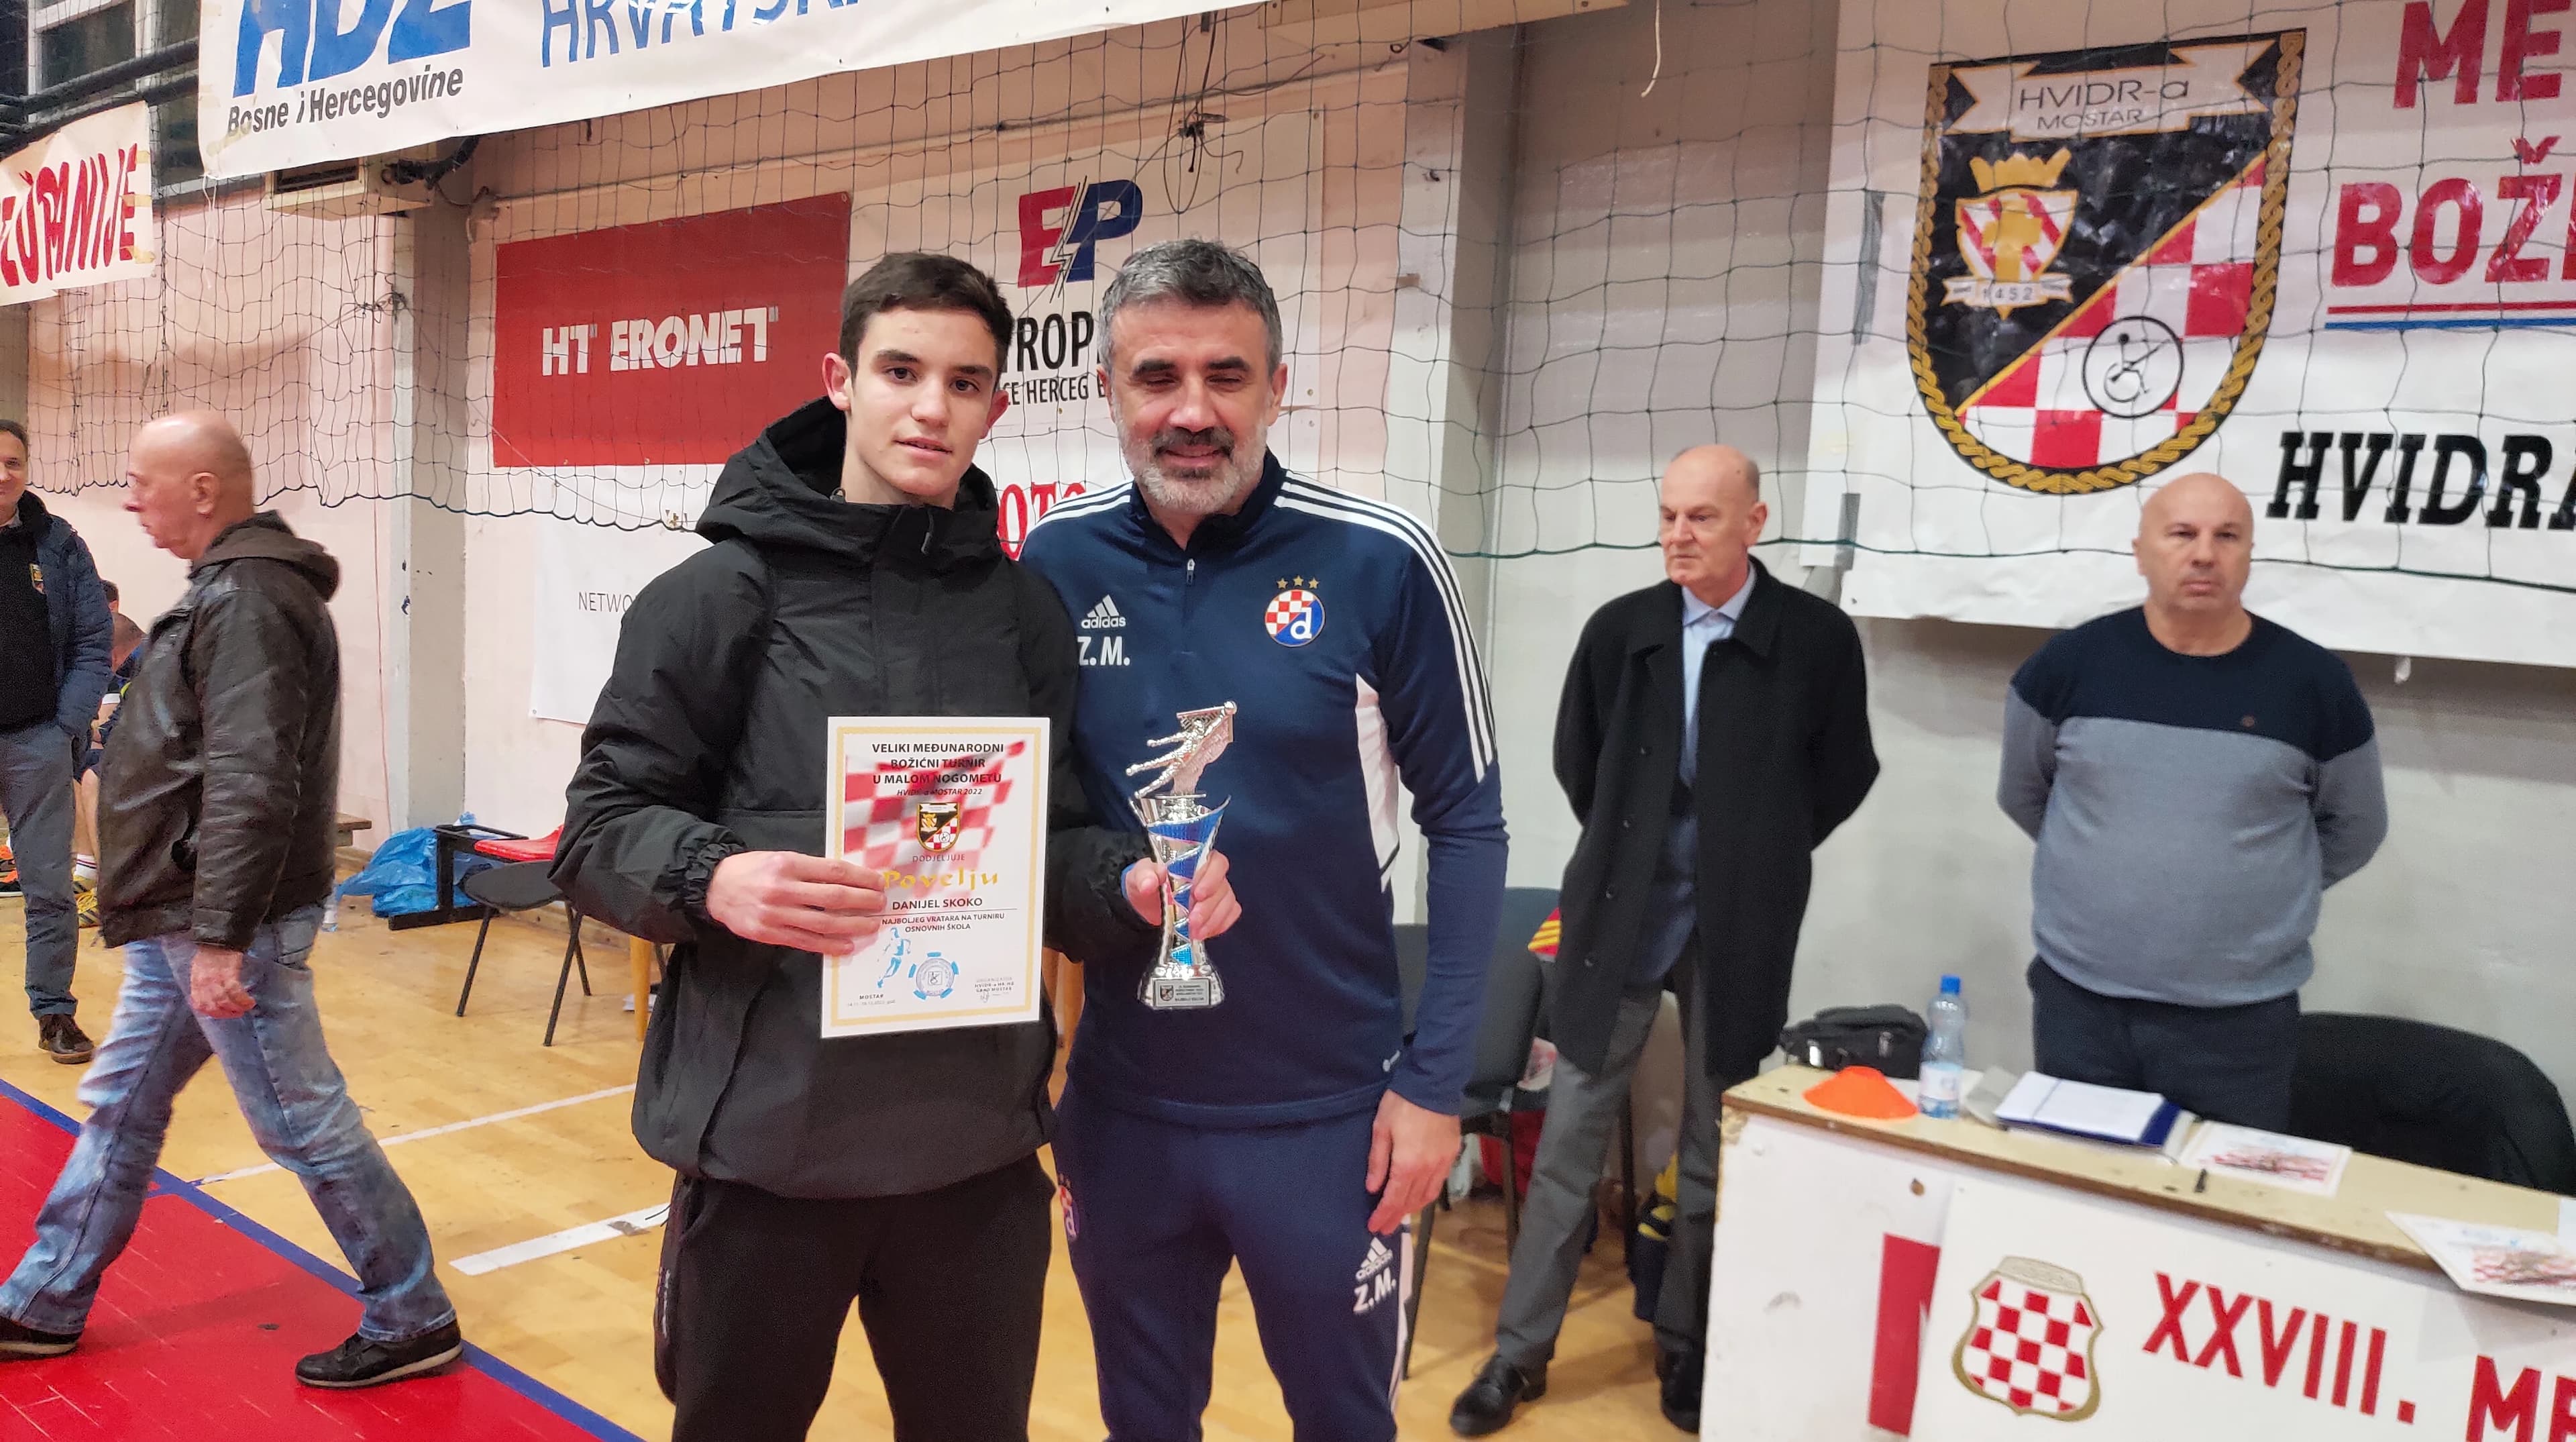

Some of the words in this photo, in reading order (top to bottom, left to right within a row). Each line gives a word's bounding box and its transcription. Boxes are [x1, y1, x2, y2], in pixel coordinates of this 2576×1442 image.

[227, 100, 288, 136] Bosne
[296, 91, 305, 123] i
[309, 64, 464, 122] Hercegovine
[2019, 79, 2190, 111] HVIDR-a
[2037, 109, 2143, 130] MOSTAR
[542, 325, 588, 376] HT
[610, 307, 767, 372] ERONET
[1026, 375, 1089, 404] HERCEG
[1081, 615, 1126, 629] adidas
[872, 743, 910, 753] VELIKI
[913, 743, 1004, 753] MEĐUNARODNI
[891, 757, 939, 768] BOŽIĆNI
[943, 758, 985, 768] TURNIR
[873, 774, 881, 784] U
[884, 774, 930, 784] MALOM
[933, 774, 1002, 783] NOGOMETU
[912, 854, 965, 862] DODJELJUJE
[882, 866, 999, 891] Povelju
[892, 899, 941, 911] DANIJEL
[943, 898, 983, 908] SKOKO
[882, 915, 925, 925] NAJBOLJEG
[926, 915, 960, 923] VRATARA
[905, 925, 945, 933] OSNOVNIH
[2143, 1271, 2416, 1424] XXVIII.
